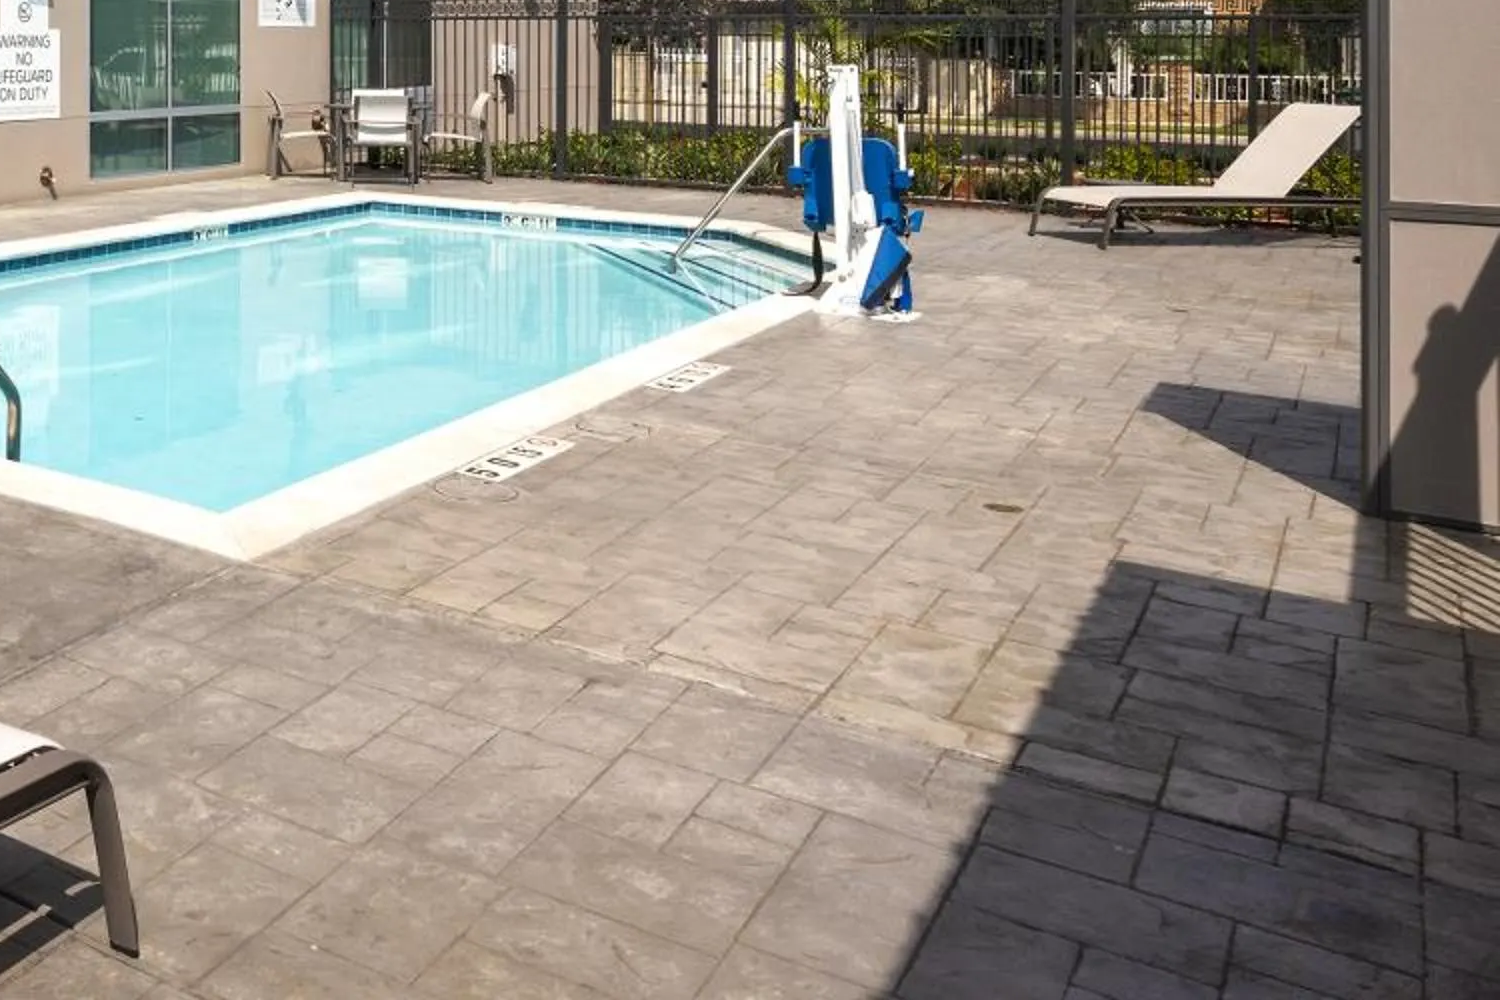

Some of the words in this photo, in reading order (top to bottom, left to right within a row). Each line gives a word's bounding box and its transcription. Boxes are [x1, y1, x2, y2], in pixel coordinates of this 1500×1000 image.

[15, 52, 33, 66] NO
[0, 88, 16, 102] ON
[19, 86, 49, 100] DUTY
